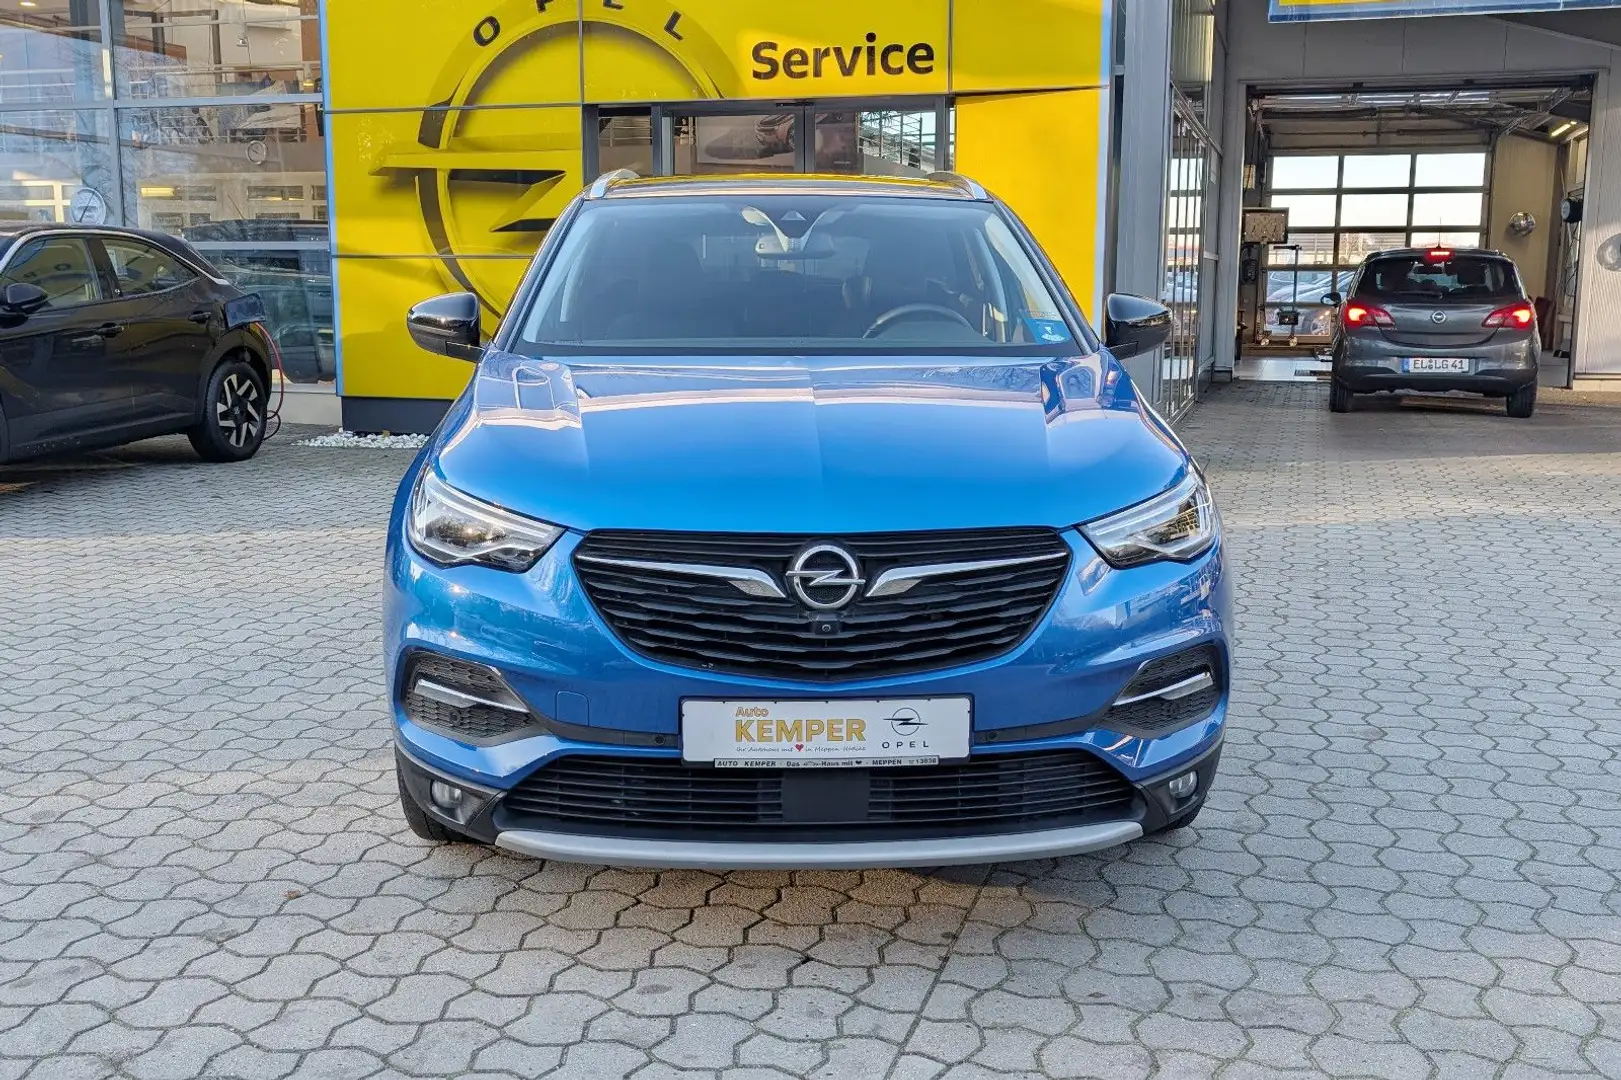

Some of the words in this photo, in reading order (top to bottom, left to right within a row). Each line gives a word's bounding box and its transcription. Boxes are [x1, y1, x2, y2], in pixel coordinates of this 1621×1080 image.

[751, 32, 935, 80] Service
[1413, 359, 1427, 369] EL
[1434, 359, 1449, 369] LG
[1451, 359, 1464, 370] 41
[735, 706, 769, 717] Auto
[735, 718, 867, 742] KEMPER
[881, 740, 930, 749] OPEL
